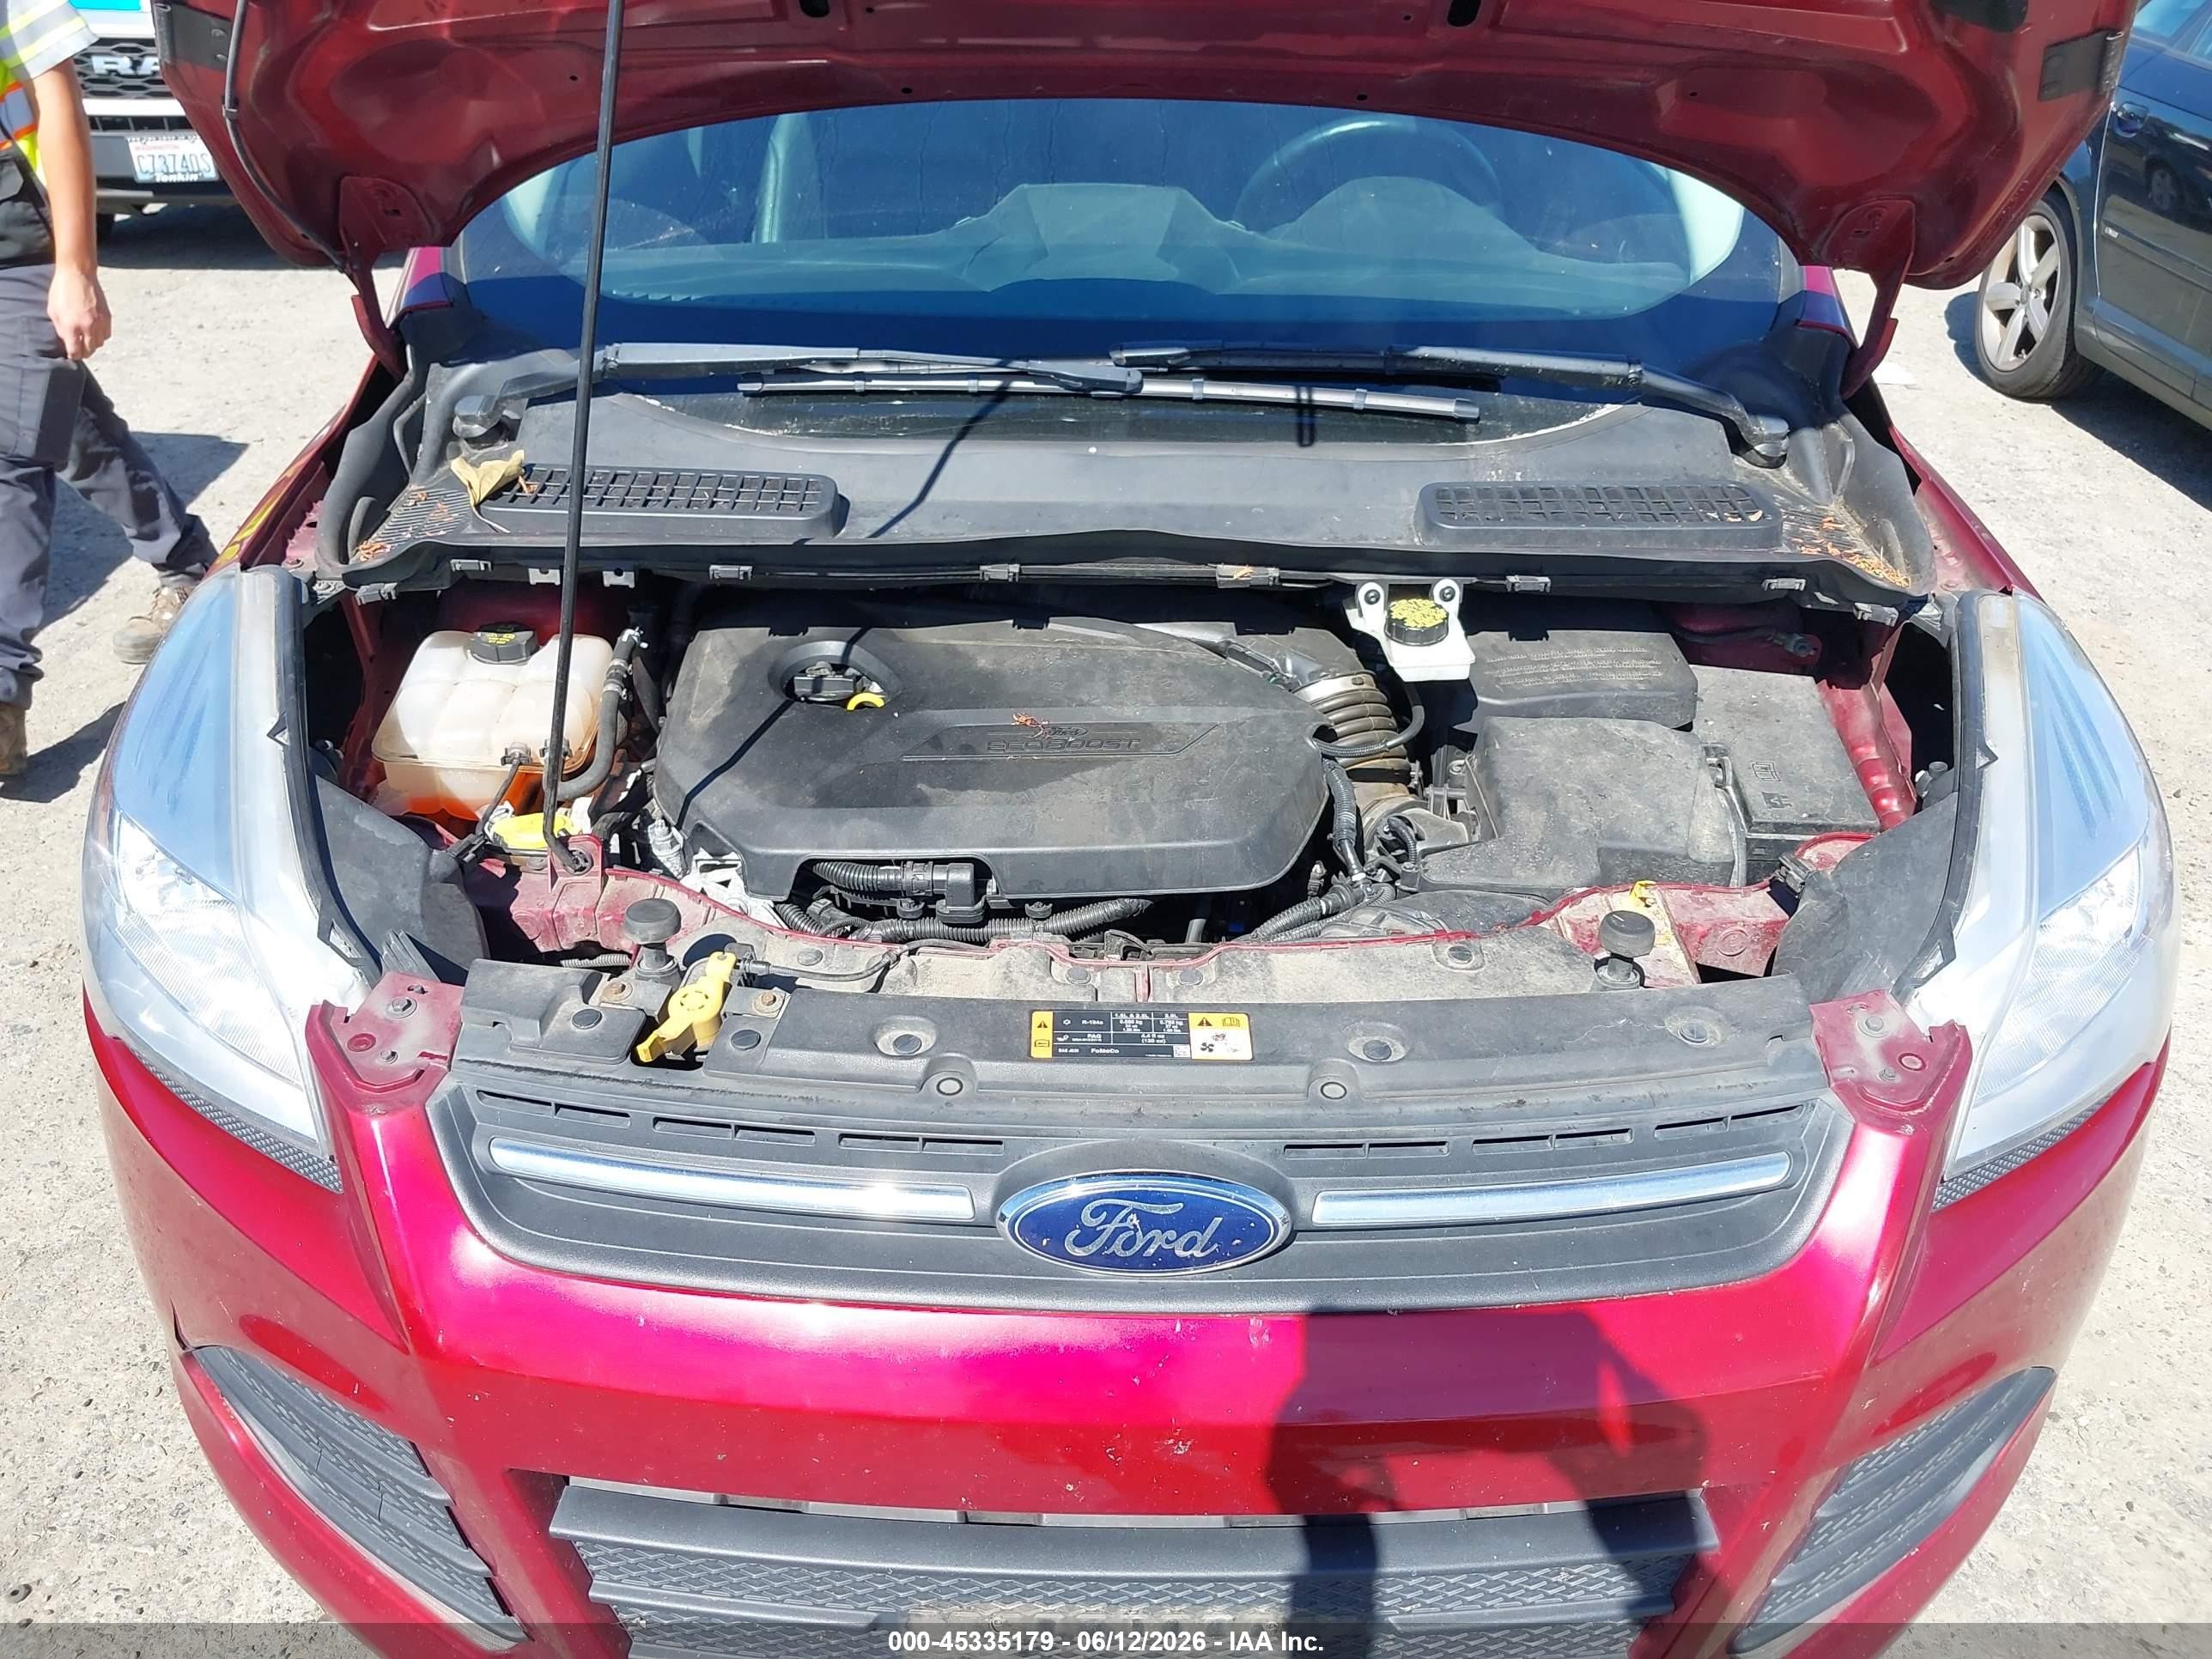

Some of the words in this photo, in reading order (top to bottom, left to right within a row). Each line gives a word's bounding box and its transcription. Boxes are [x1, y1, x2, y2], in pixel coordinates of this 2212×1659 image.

[91, 55, 161, 76] RA
[988, 738, 1141, 753] ECOBOOST
[1063, 1197, 1223, 1259] Ford
